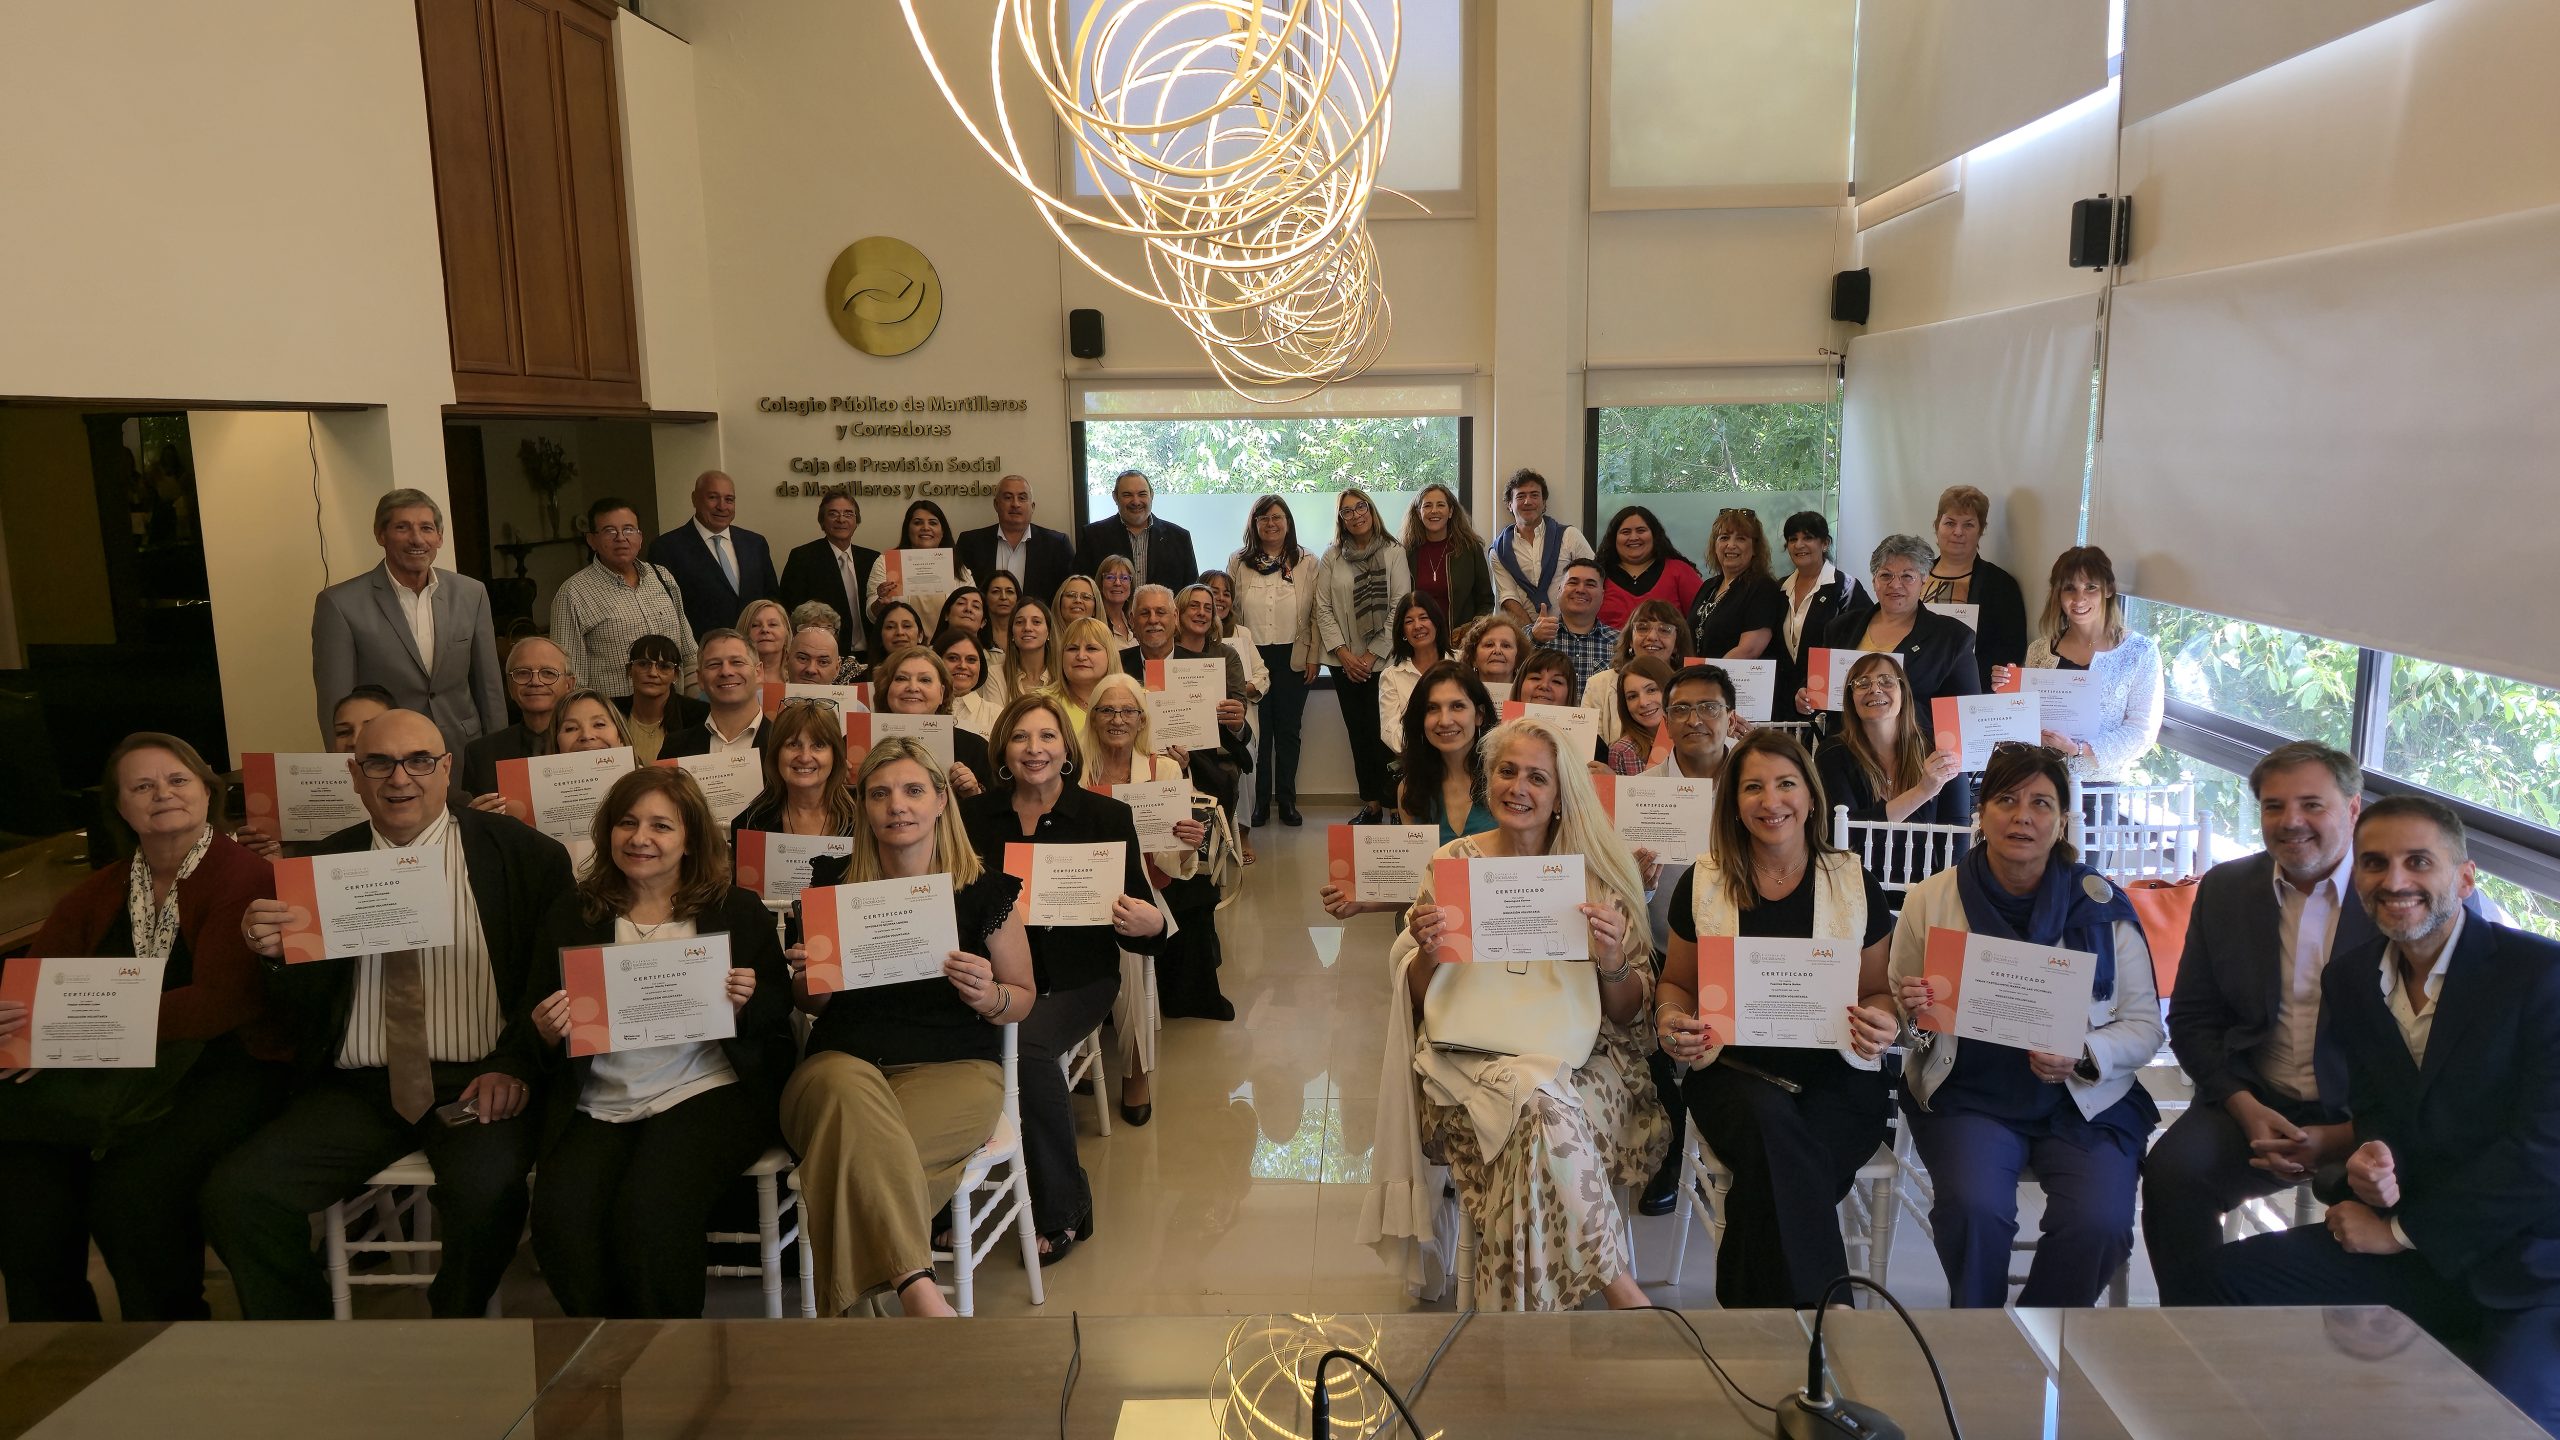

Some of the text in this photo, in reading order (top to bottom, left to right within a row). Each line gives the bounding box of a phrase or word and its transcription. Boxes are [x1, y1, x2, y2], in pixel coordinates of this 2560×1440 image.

[759, 396, 1027, 416] Colegio Público de Martilleros
[836, 420, 951, 441] y Corredores
[790, 456, 1001, 476] Caja de Previsión Social
[776, 481, 800, 496] de
[903, 484, 916, 500] y
[919, 480, 999, 496] Corredor
[553, 777, 599, 787] CERTIFICADO
[344, 880, 400, 891] CERTIFICADO
[1495, 887, 1545, 895] CERTIFICADO
[863, 909, 914, 920] CERTIFICADO
[633, 971, 688, 982] CERTIFICADO
[1990, 970, 2046, 984] CERTIFICADO
